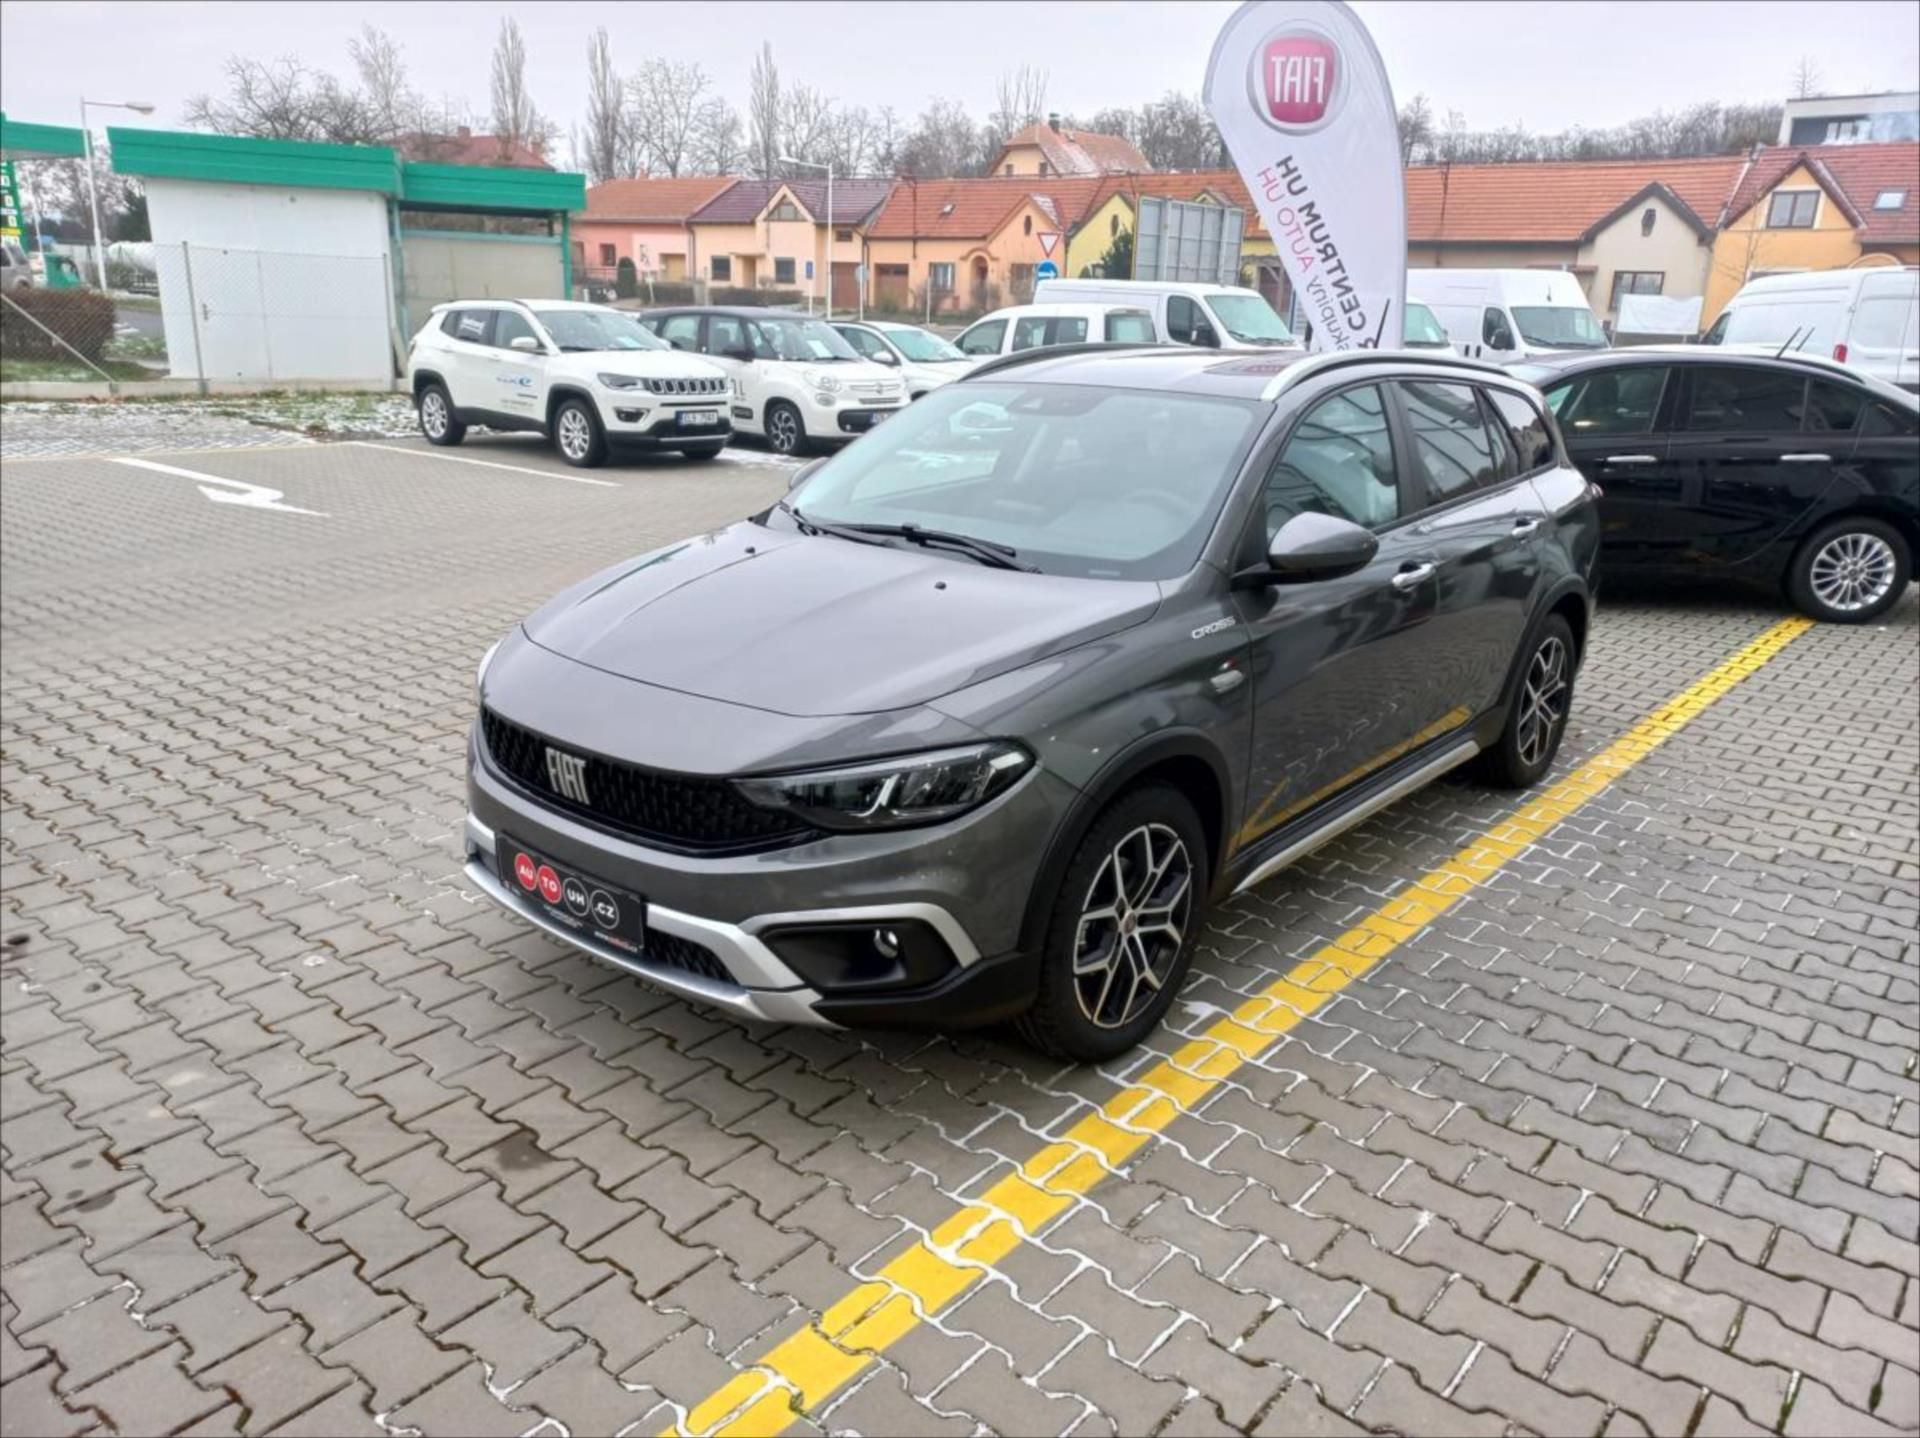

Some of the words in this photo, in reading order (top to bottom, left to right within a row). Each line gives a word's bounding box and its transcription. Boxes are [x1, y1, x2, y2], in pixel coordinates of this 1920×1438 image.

[1191, 615, 1237, 639] CROSS
[546, 747, 590, 805] FIAT
[541, 876, 558, 891] TO
[567, 888, 585, 905] UH
